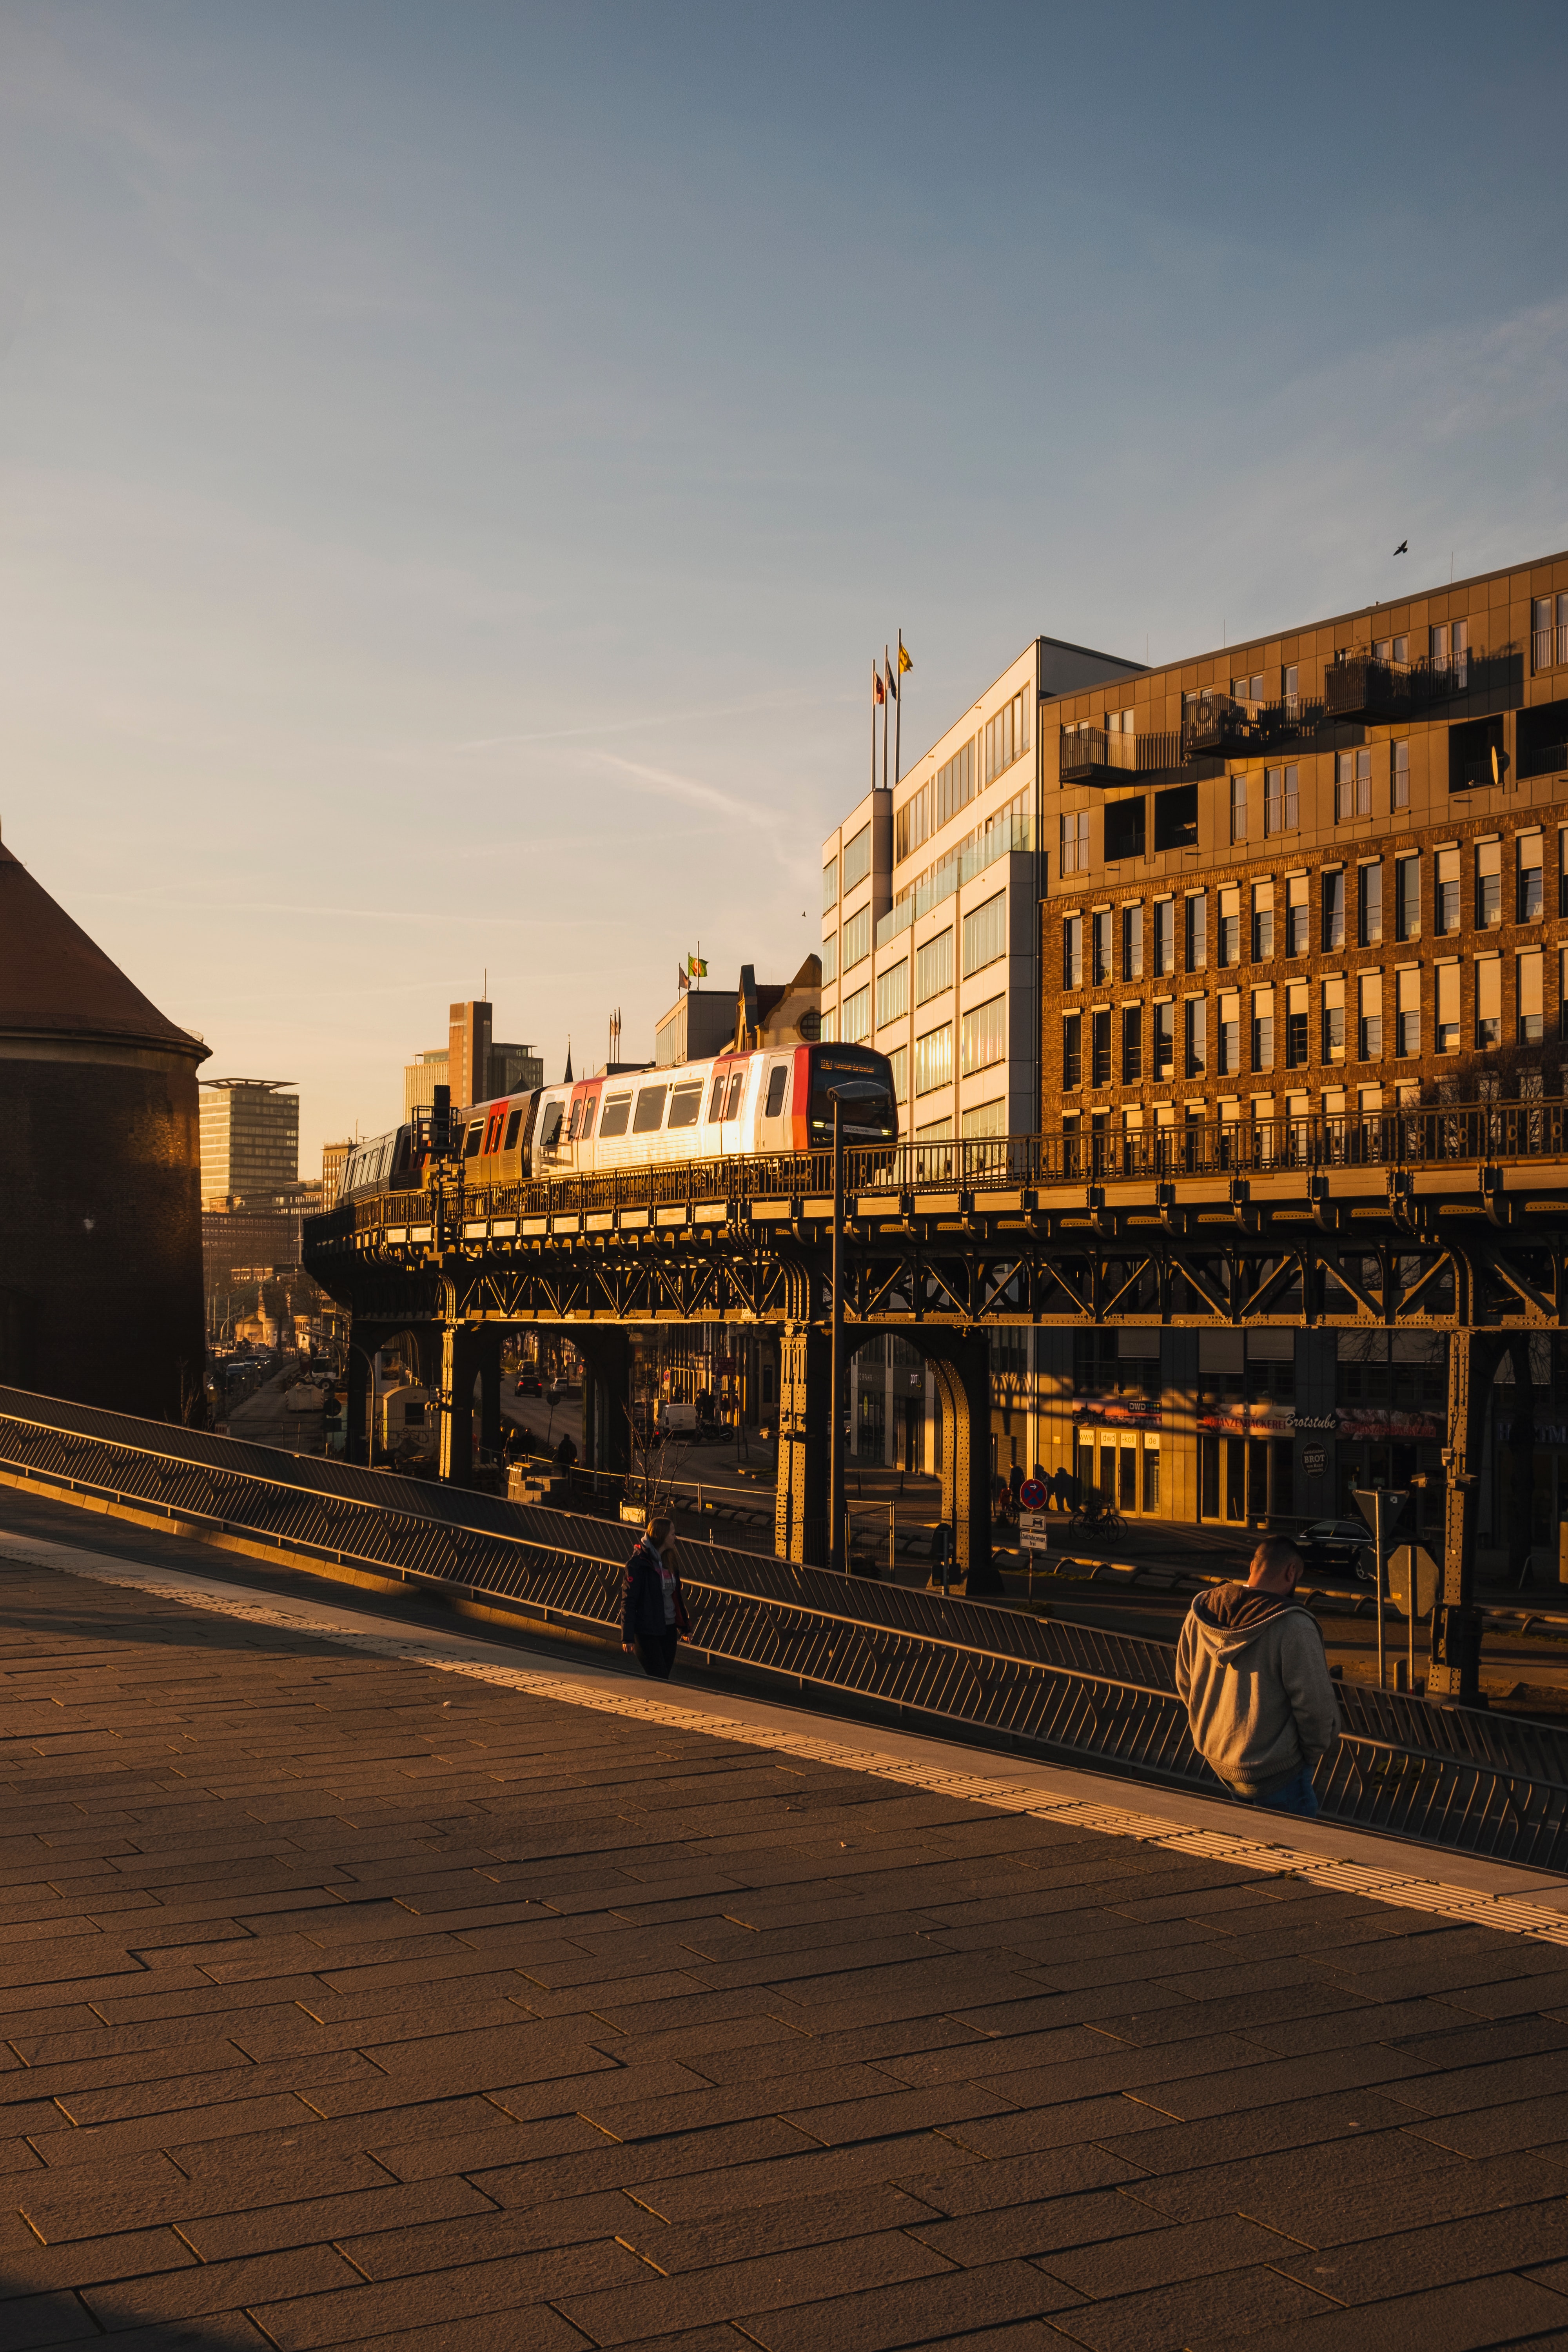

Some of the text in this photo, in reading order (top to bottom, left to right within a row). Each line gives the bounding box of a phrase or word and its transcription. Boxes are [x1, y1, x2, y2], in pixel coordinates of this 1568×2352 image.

[1073, 1414, 1111, 1425] Gallery
[1203, 1412, 1336, 1430] SCHANZENBÄCKEREI Brotstube
[1342, 1423, 1437, 1437] SCHANZENBÄCKEREI
[1496, 1422, 1568, 1443] HTM
[1102, 1432, 1115, 1442] .dwd
[1147, 1436, 1156, 1445] .de
[1304, 1454, 1325, 1463] BROT
[1022, 1534, 1045, 1542] Zollfahrzeuge
